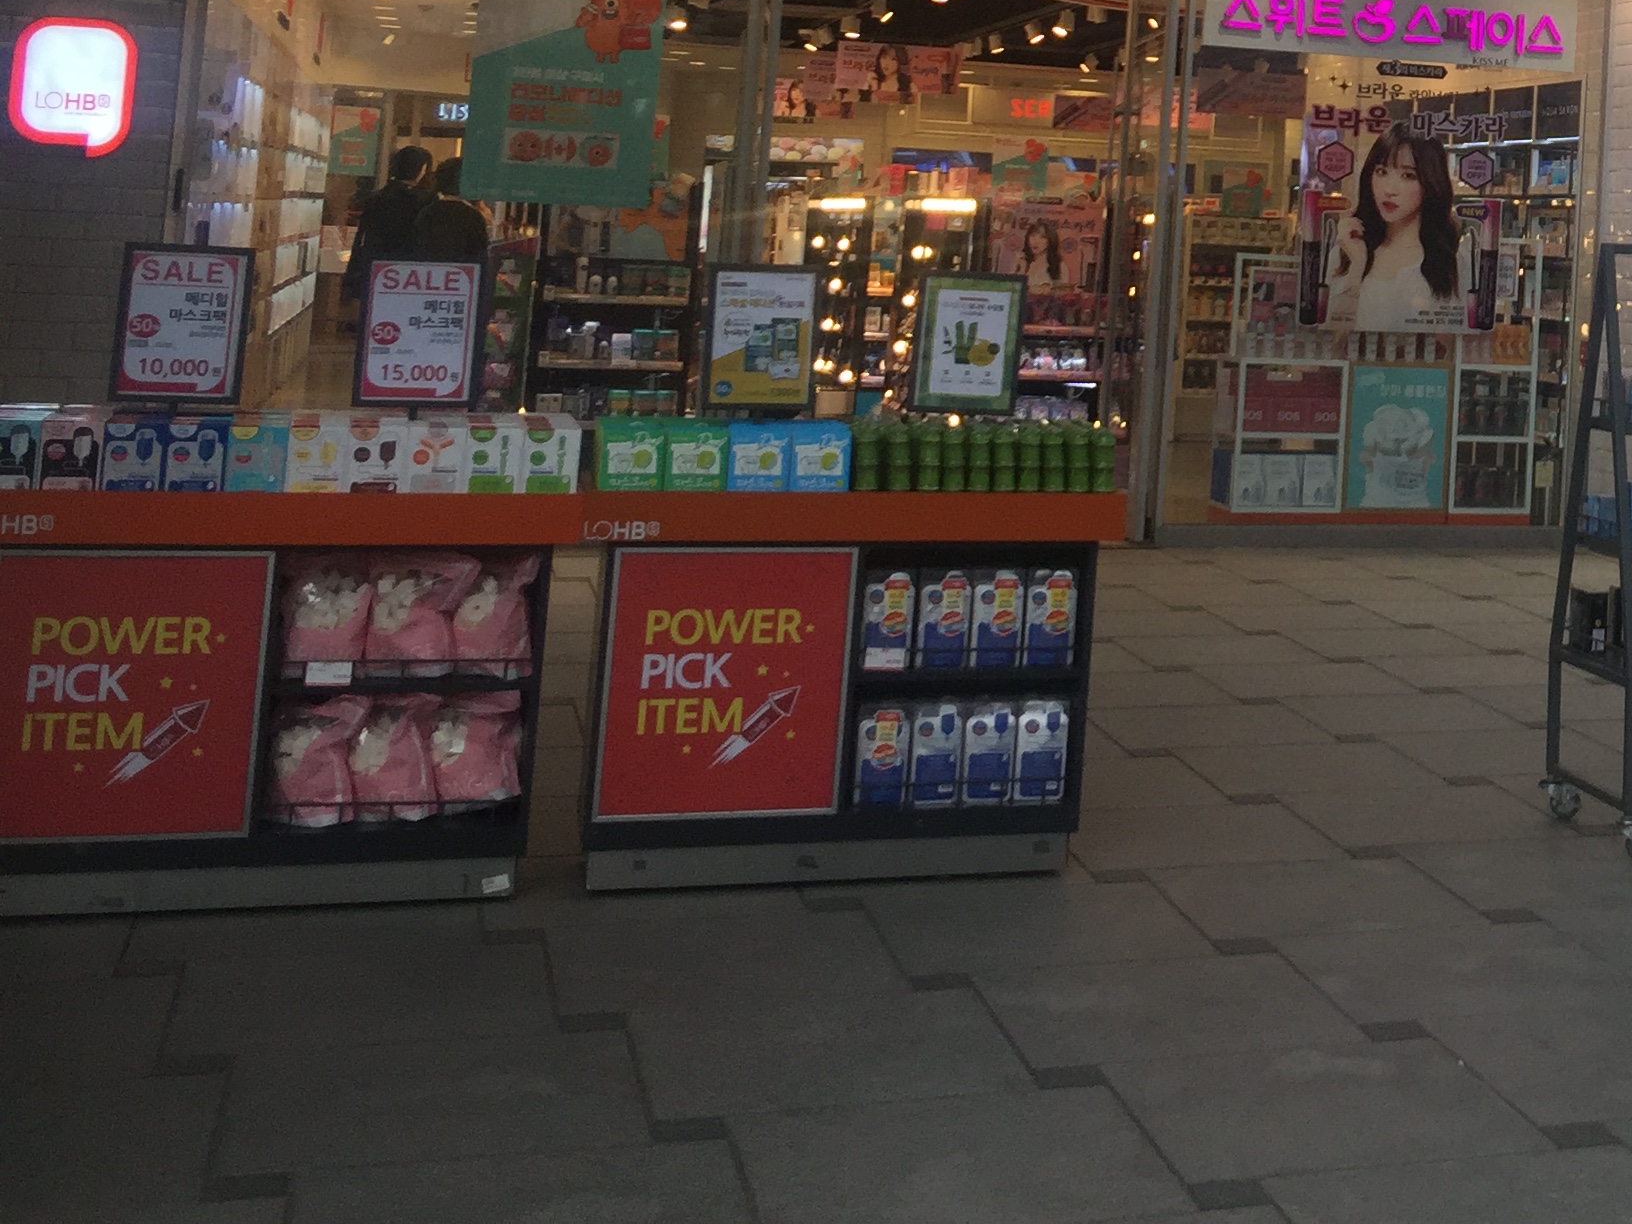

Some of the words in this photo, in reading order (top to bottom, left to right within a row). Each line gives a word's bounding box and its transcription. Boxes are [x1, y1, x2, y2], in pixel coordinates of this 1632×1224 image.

[1402, 3, 1565, 56] 스페이스
[1356, 81, 1406, 100] 브라운
[1309, 103, 1392, 137] 브라운
[1410, 110, 1510, 141] 마스카라
[1461, 207, 1486, 217] NEW
[140, 258, 226, 284] SALE
[381, 267, 462, 292] SALE
[185, 291, 229, 308] 메디힐
[423, 299, 465, 315] 메디힐
[168, 308, 228, 324] 마스크팩
[408, 316, 464, 331] 마스크팩
[139, 357, 209, 378] 10,000
[381, 363, 448, 383] 15,000
[31, 615, 213, 656] POWER
[644, 607, 803, 646] POWER
[639, 651, 732, 690] PICK
[25, 663, 132, 704] PICK
[635, 696, 745, 736] ITEM
[21, 710, 146, 753] ITEM
